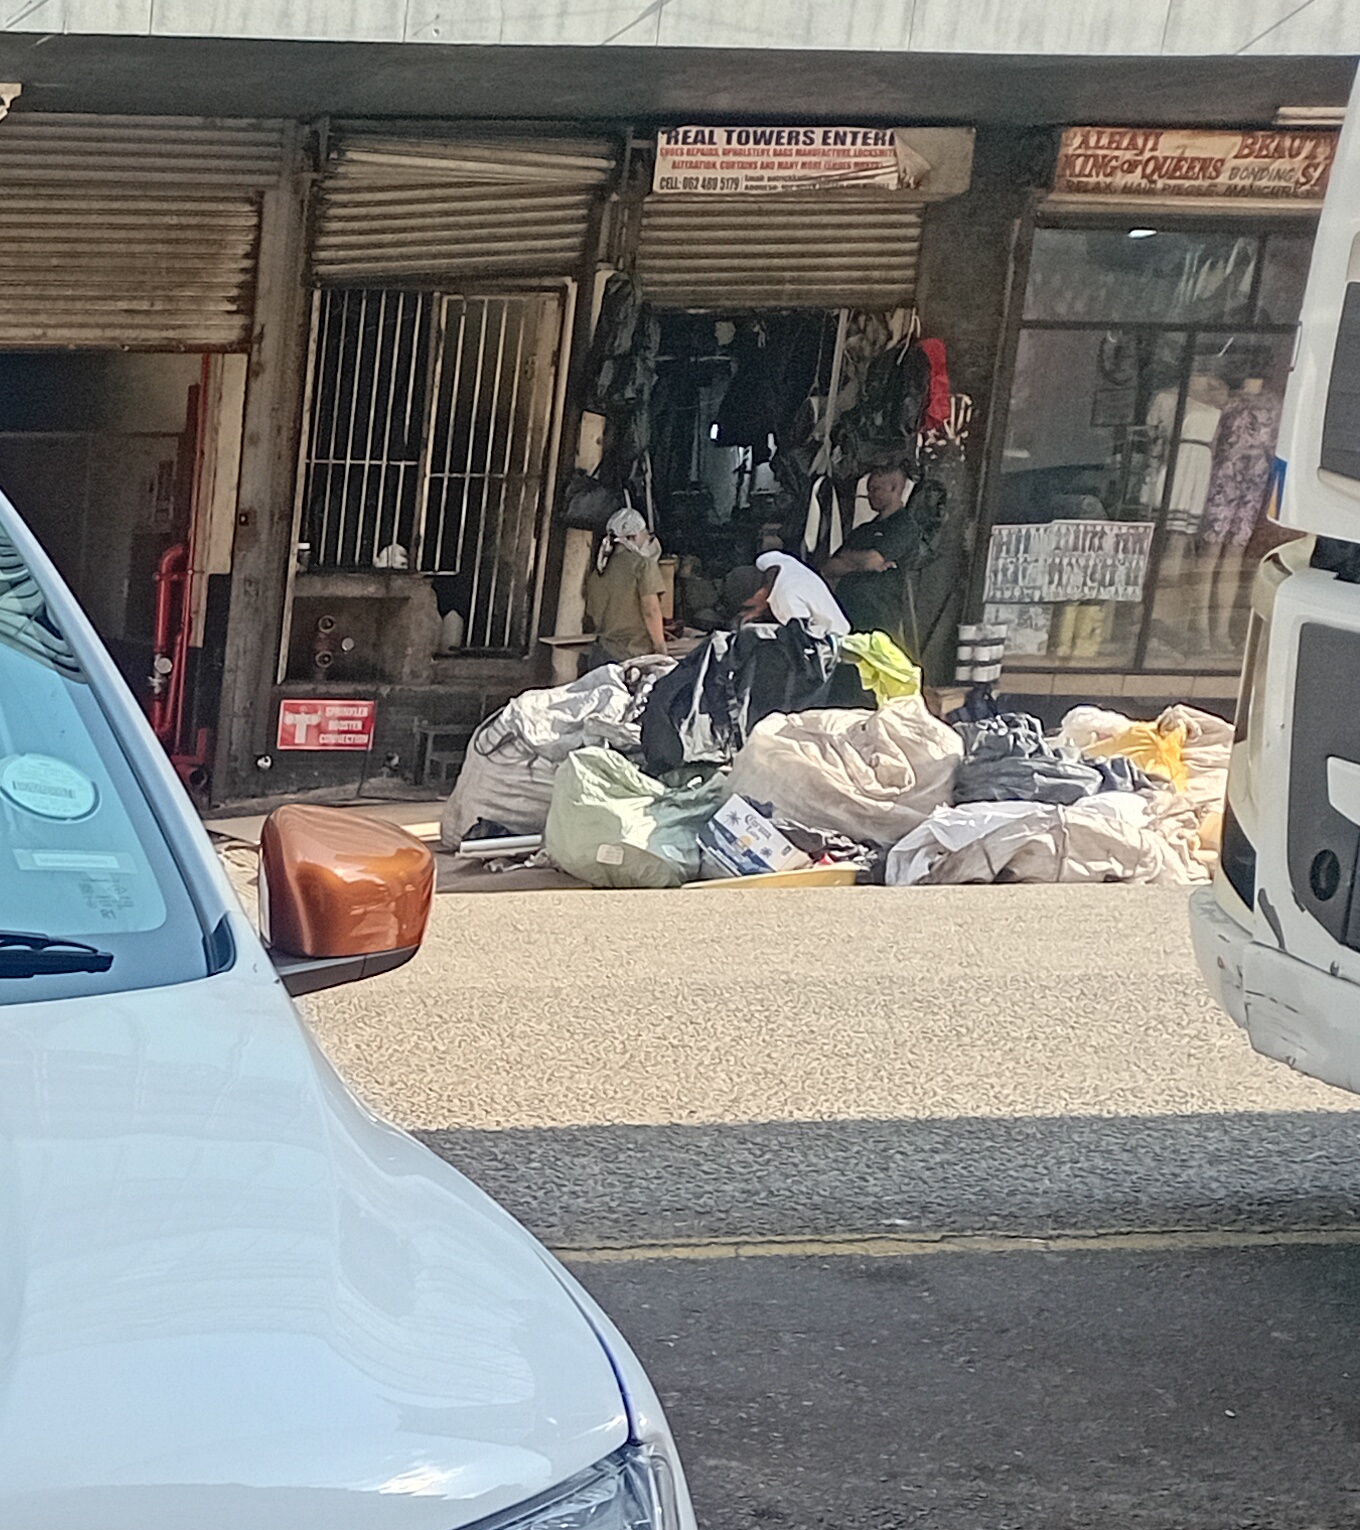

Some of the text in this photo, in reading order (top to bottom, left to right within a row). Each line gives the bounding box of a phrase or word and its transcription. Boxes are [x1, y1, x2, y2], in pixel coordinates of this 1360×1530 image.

[665, 129, 717, 146] REAL
[724, 129, 816, 146] TOWERS
[1056, 153, 1120, 179] KING
[1141, 154, 1226, 183] QUEENS
[1229, 166, 1295, 181] BONDING
